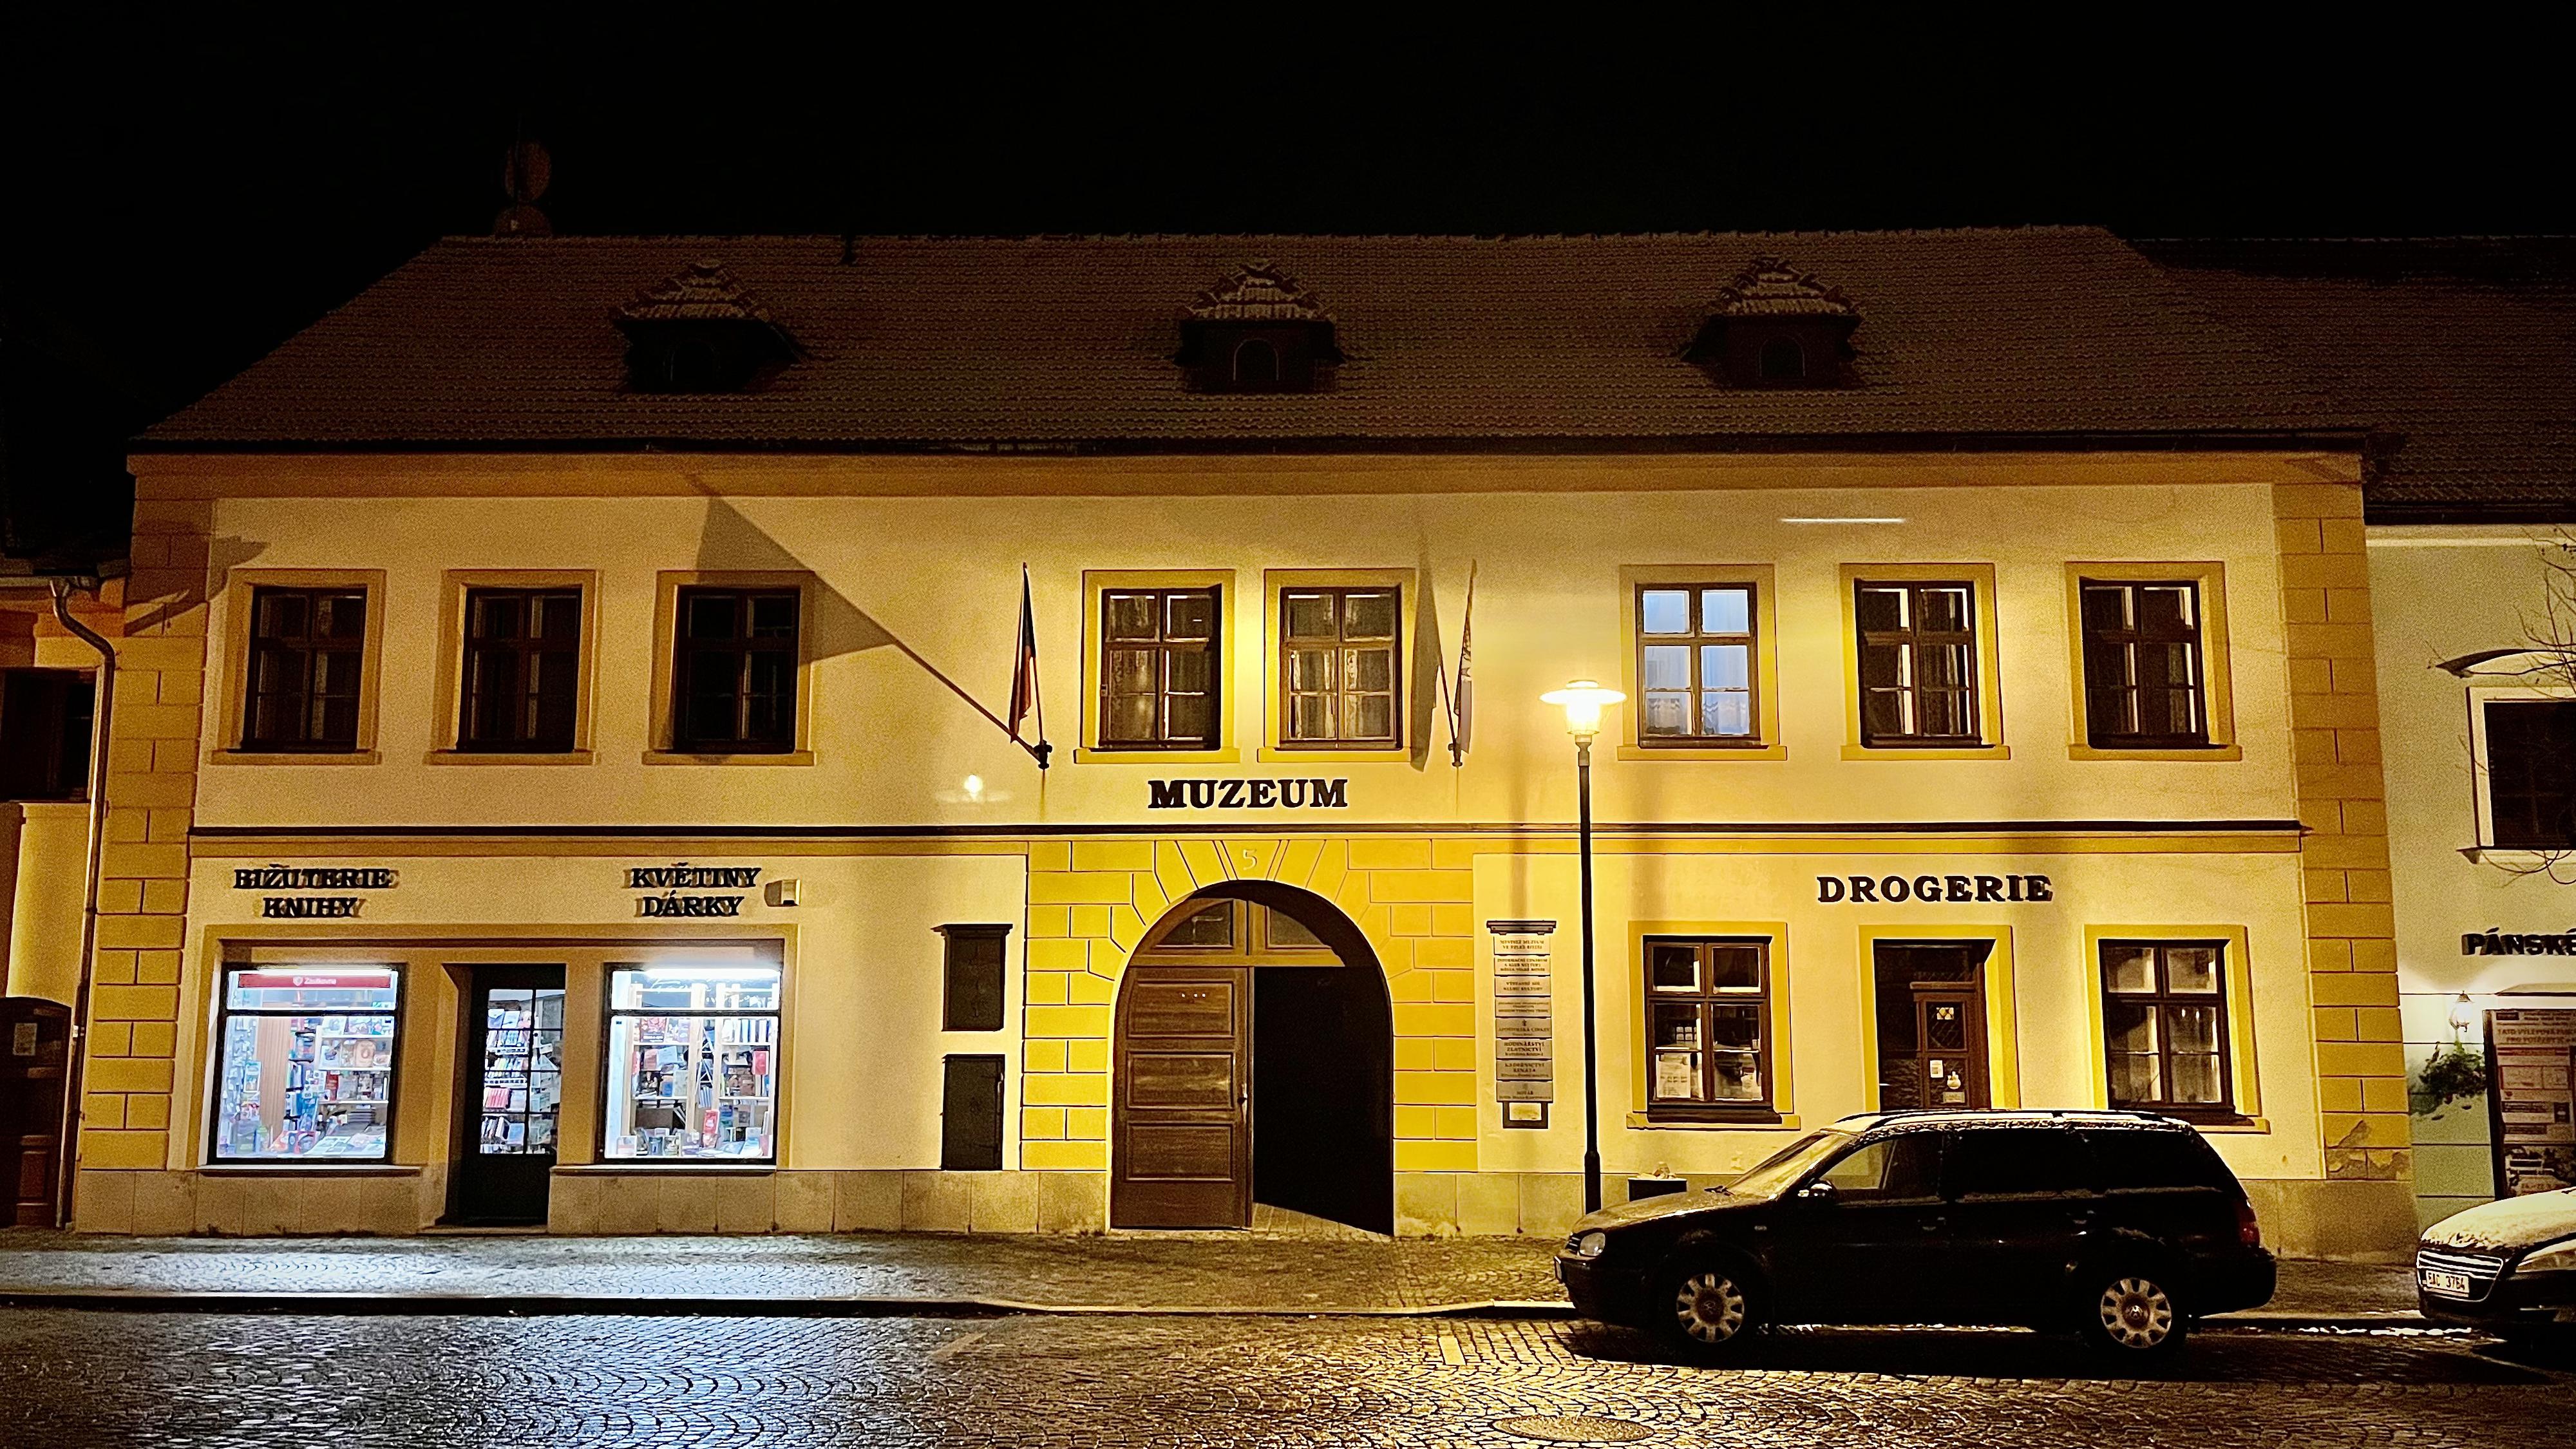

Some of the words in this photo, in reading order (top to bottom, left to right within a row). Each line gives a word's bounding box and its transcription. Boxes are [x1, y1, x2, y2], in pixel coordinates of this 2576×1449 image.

[1148, 779, 1348, 808] MUZEUM
[1242, 849, 1258, 871] 5
[233, 864, 390, 889] BIŽUTERIE
[630, 862, 762, 887] KVĚTINY
[1816, 875, 2053, 902] DROGERIE
[262, 897, 357, 918] KNIHY
[641, 889, 744, 916] DÁRKY
[2461, 927, 2576, 956] PÁNSKÉ
